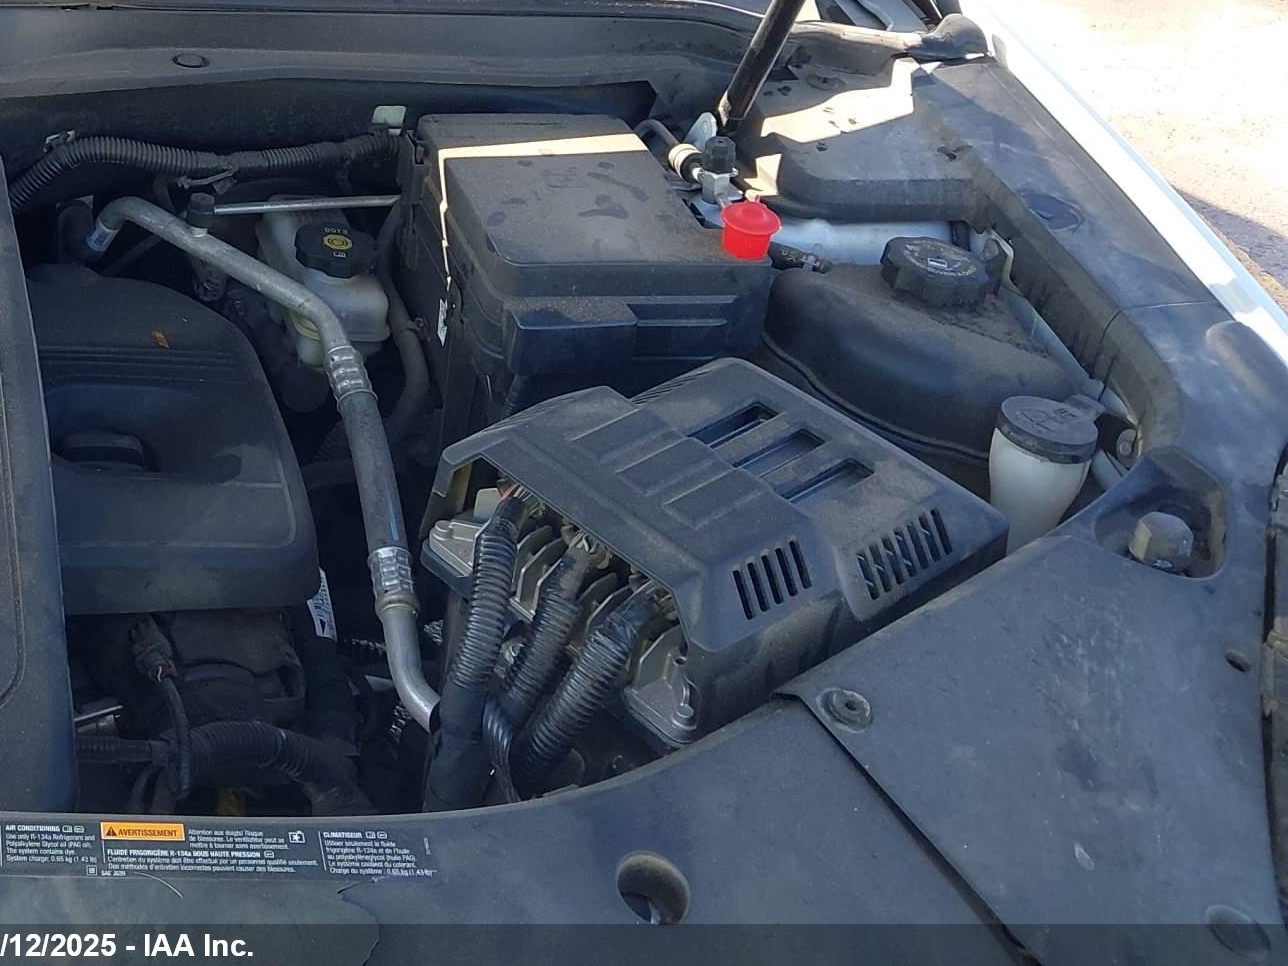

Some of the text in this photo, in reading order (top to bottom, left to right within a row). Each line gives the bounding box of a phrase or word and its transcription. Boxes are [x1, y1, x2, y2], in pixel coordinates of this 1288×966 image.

[5, 824, 16, 832] AIR
[118, 829, 177, 837] AVERTISSEMENT
[323, 831, 363, 839] CLIMATISEUR
[18, 847, 39, 855] system
[107, 848, 128, 856] FLUIDE
[210, 850, 230, 858] HAUTE
